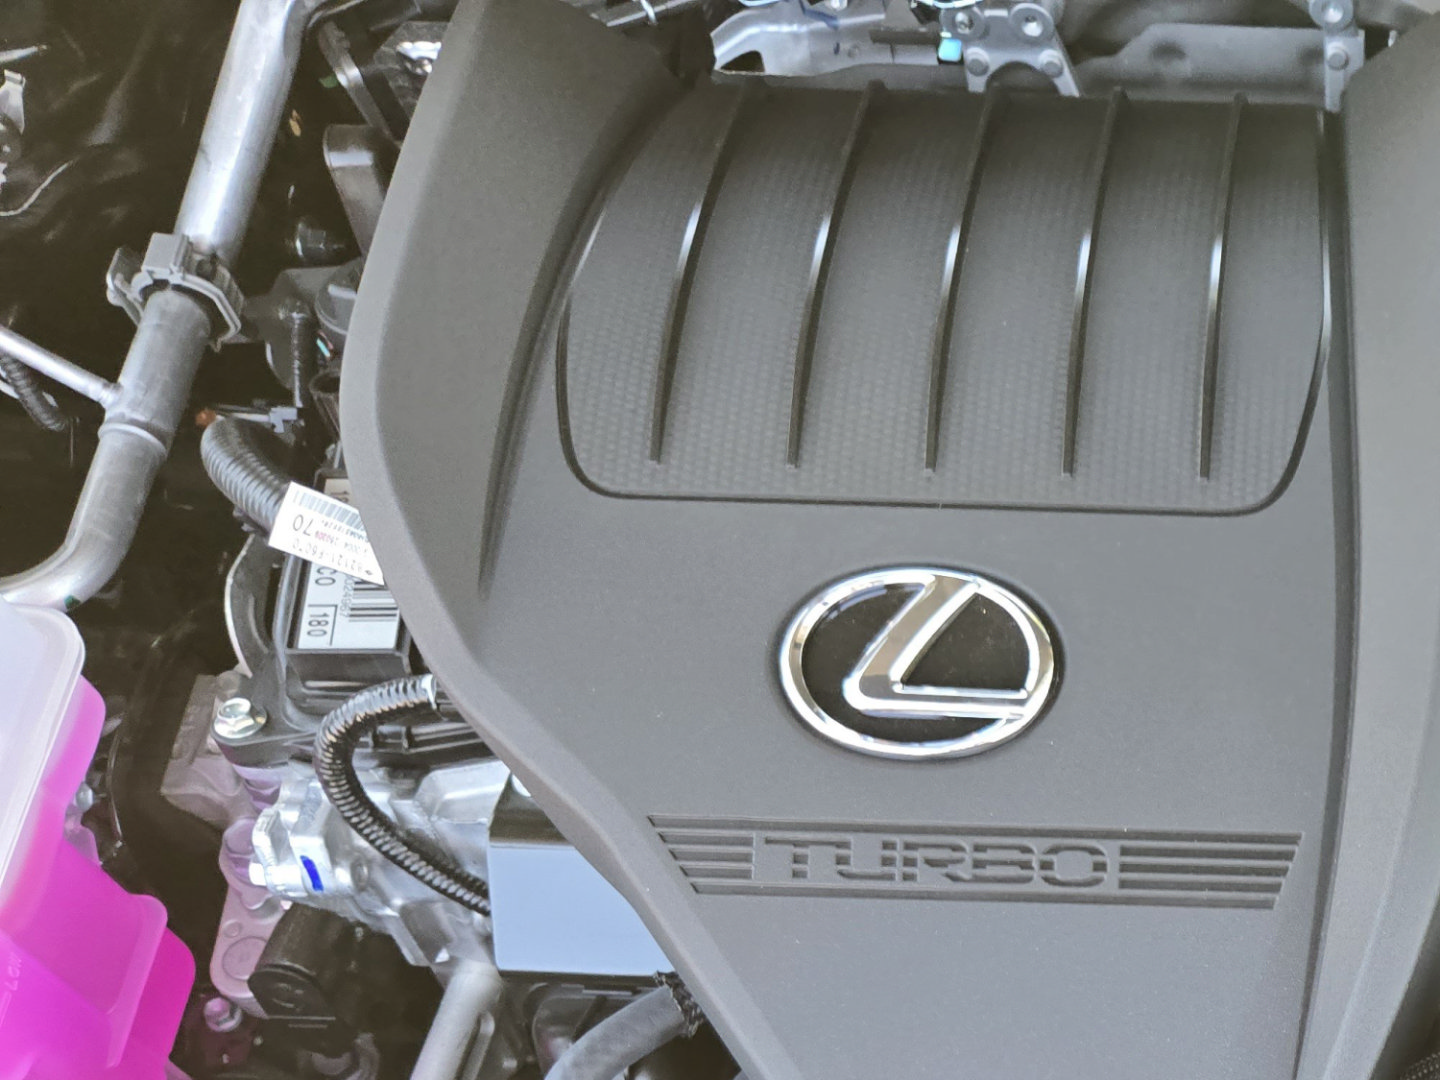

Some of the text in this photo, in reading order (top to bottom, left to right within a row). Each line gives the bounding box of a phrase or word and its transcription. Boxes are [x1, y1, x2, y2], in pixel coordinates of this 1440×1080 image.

[290, 511, 316, 536] 70
[339, 573, 354, 618] 024967
[307, 612, 329, 637] 180
[764, 836, 1111, 889] TURBO
